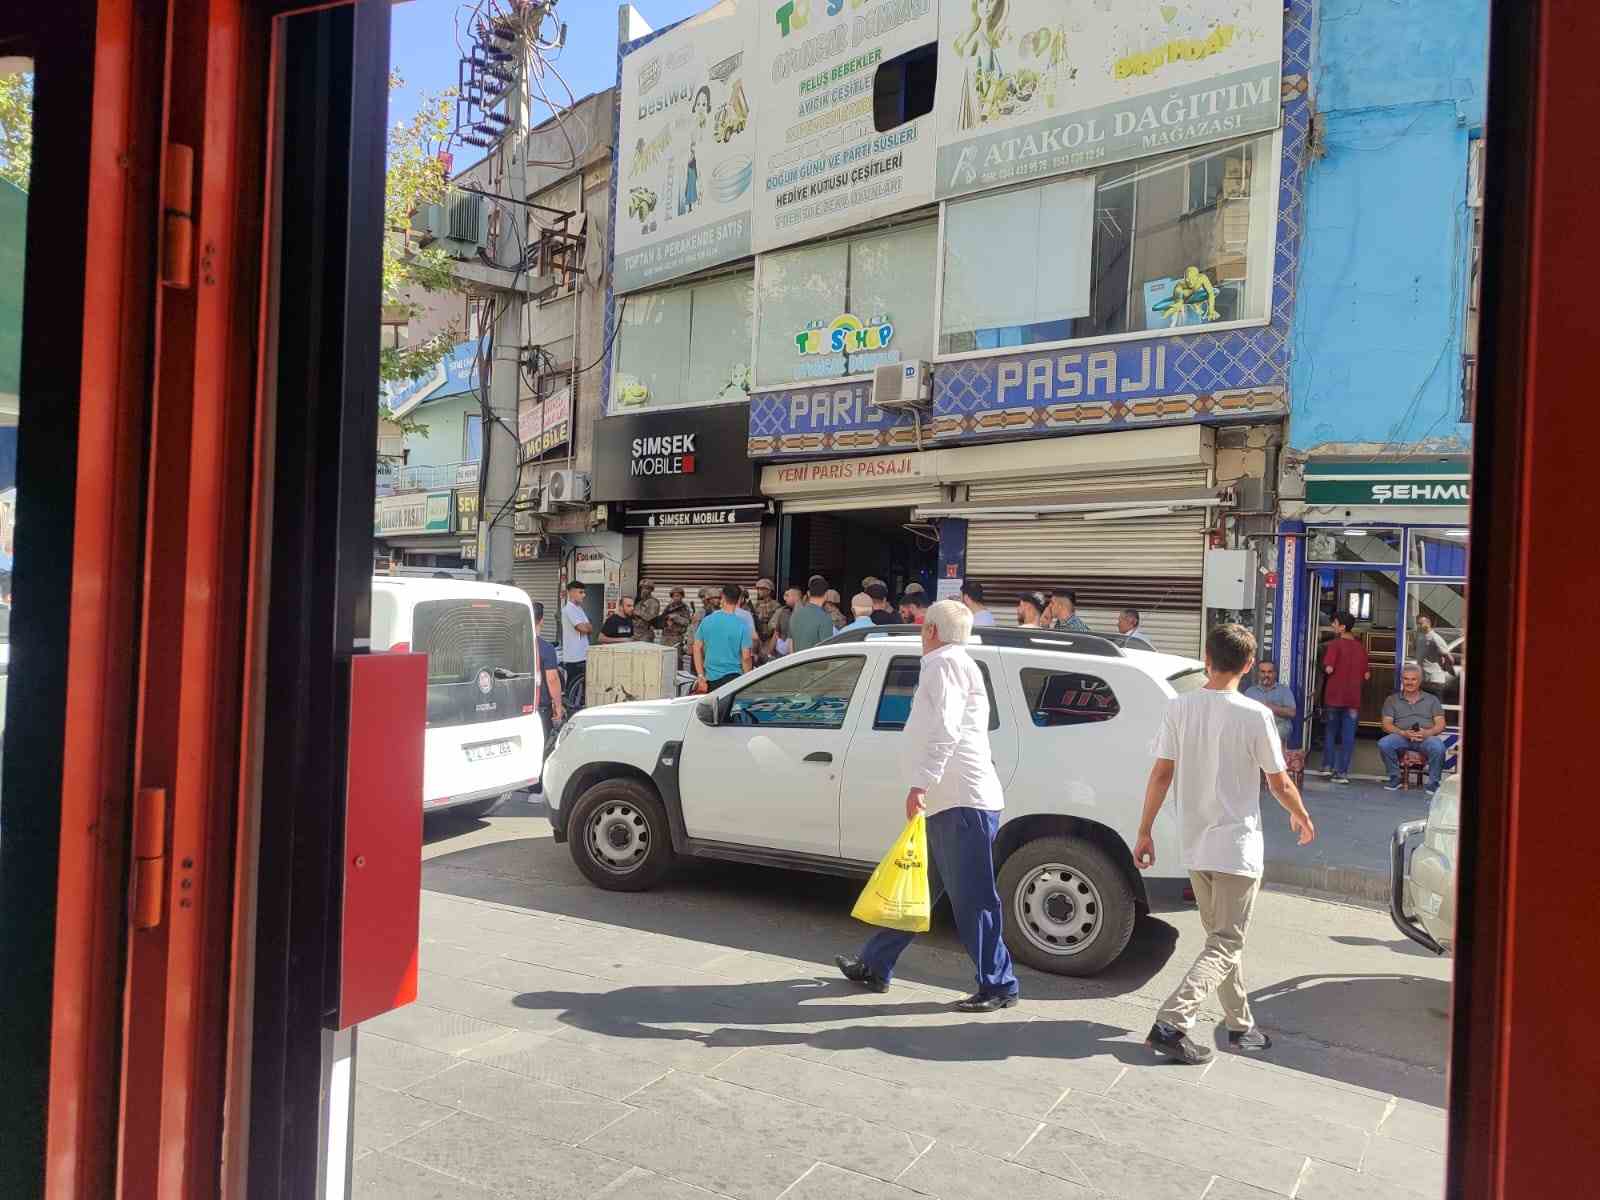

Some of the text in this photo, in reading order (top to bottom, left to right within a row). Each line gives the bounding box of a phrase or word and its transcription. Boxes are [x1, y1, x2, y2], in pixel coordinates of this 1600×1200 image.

[831, 48, 881, 80] BEBEKLER
[983, 76, 1273, 167] ATAKOL DAĞITIM
[1142, 115, 1242, 149] MAĞAZASI
[776, 152, 903, 207] HEDİYE KUTUSU ÇEŞİTLERİ
[997, 344, 1166, 403] PASAJI
[631, 456, 682, 476] MOBILE
